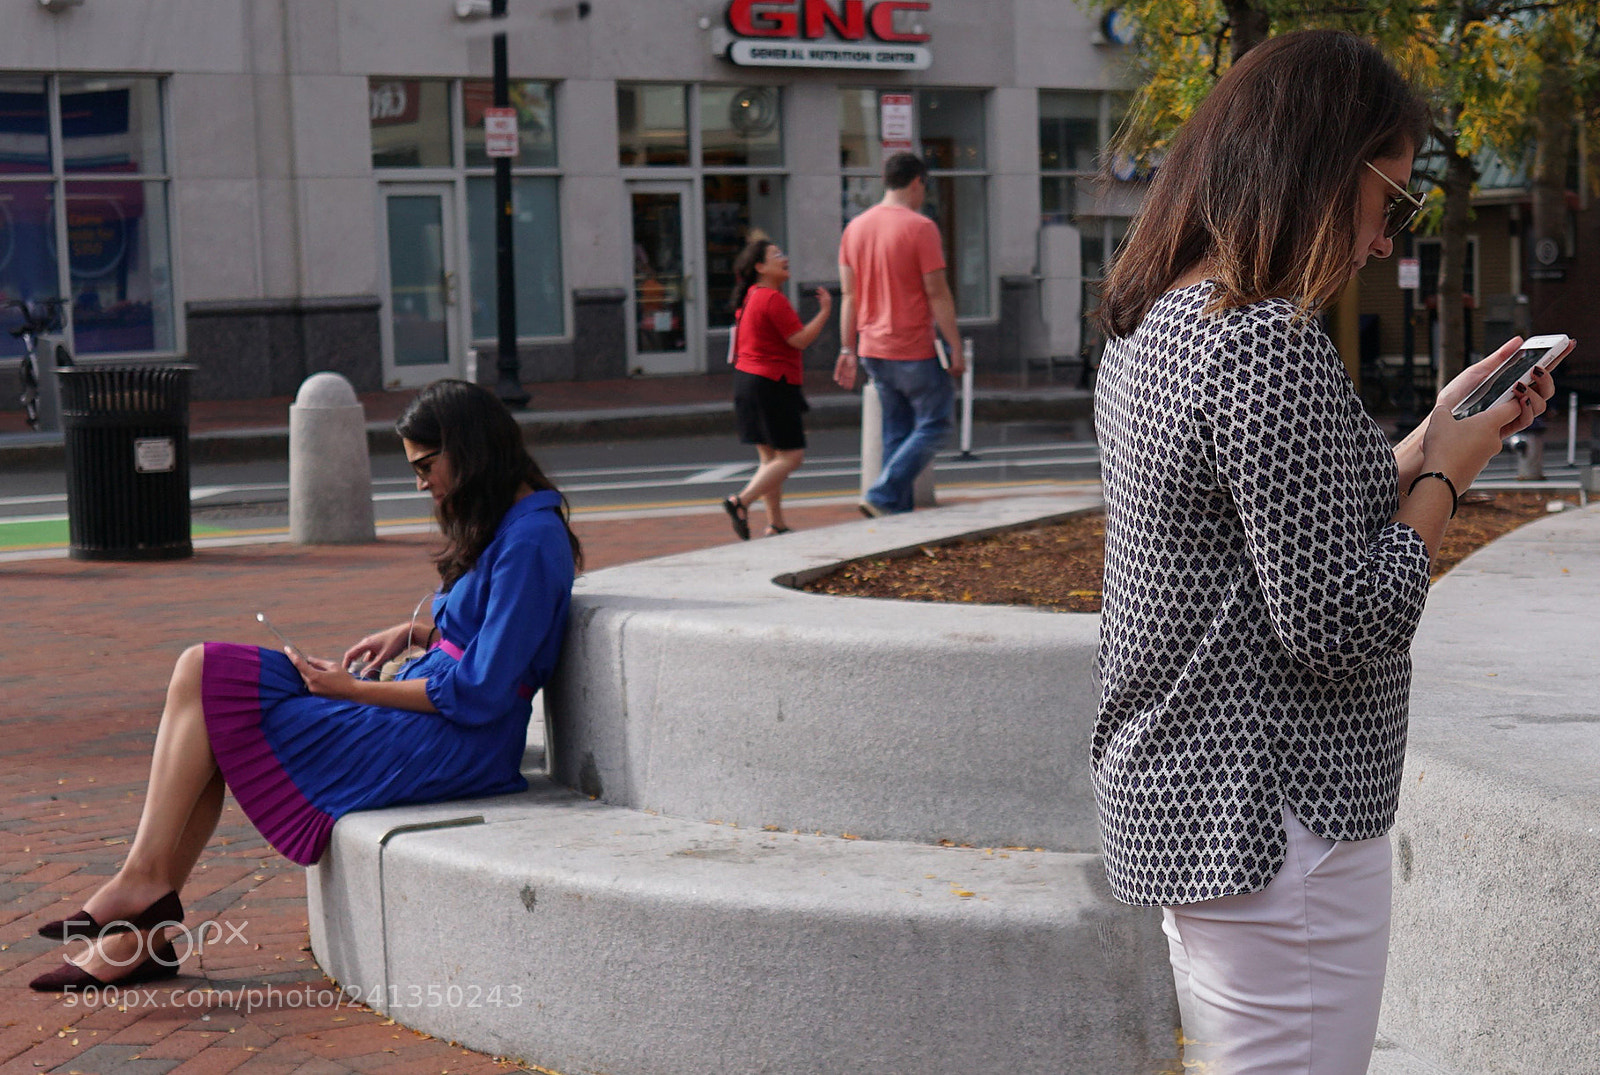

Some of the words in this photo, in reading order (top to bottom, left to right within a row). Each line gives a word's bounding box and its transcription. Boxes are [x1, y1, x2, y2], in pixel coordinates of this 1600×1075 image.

[728, 0, 930, 42] GNC
[750, 48, 804, 60] GENERAL
[808, 49, 872, 62] NUTRITION
[875, 52, 916, 64] CENTER
